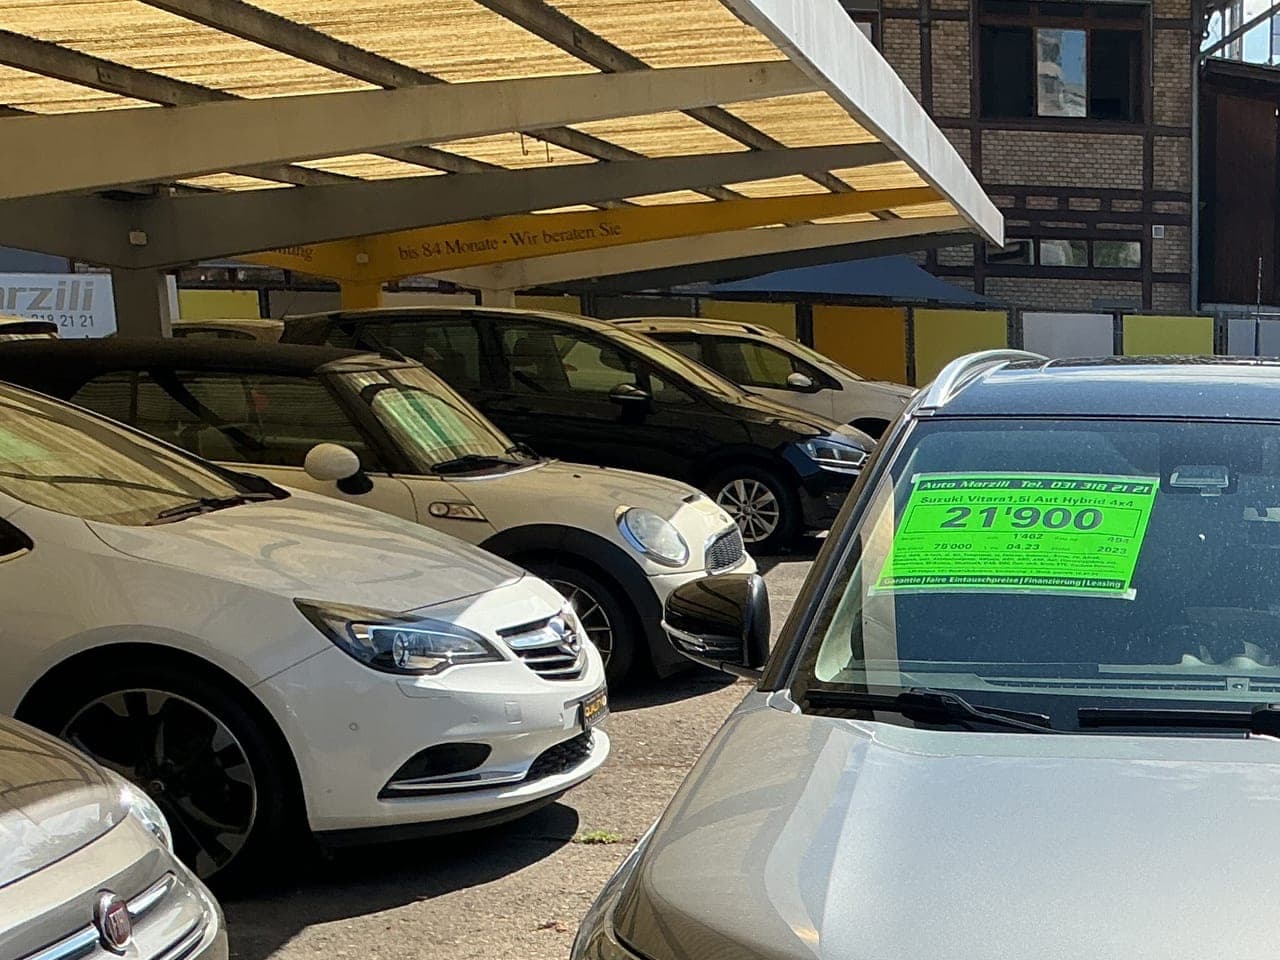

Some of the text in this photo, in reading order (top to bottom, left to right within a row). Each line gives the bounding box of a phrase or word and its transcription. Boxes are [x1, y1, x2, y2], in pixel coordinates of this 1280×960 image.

[398, 222, 622, 260] bis 84 Monate Wir beraten Sie
[0, 280, 94, 311] rzili
[60, 314, 74, 327] 21
[80, 315, 94, 328] 21
[921, 481, 956, 489] Auto
[1021, 480, 1044, 489] Tel.
[1050, 481, 1076, 489] 031
[1111, 484, 1128, 492] 21
[1132, 485, 1150, 493] 21
[920, 495, 963, 504] Suzuki
[1034, 495, 1058, 503] Aut
[1063, 496, 1106, 507] Hybrid
[940, 506, 1103, 531] 21'900
